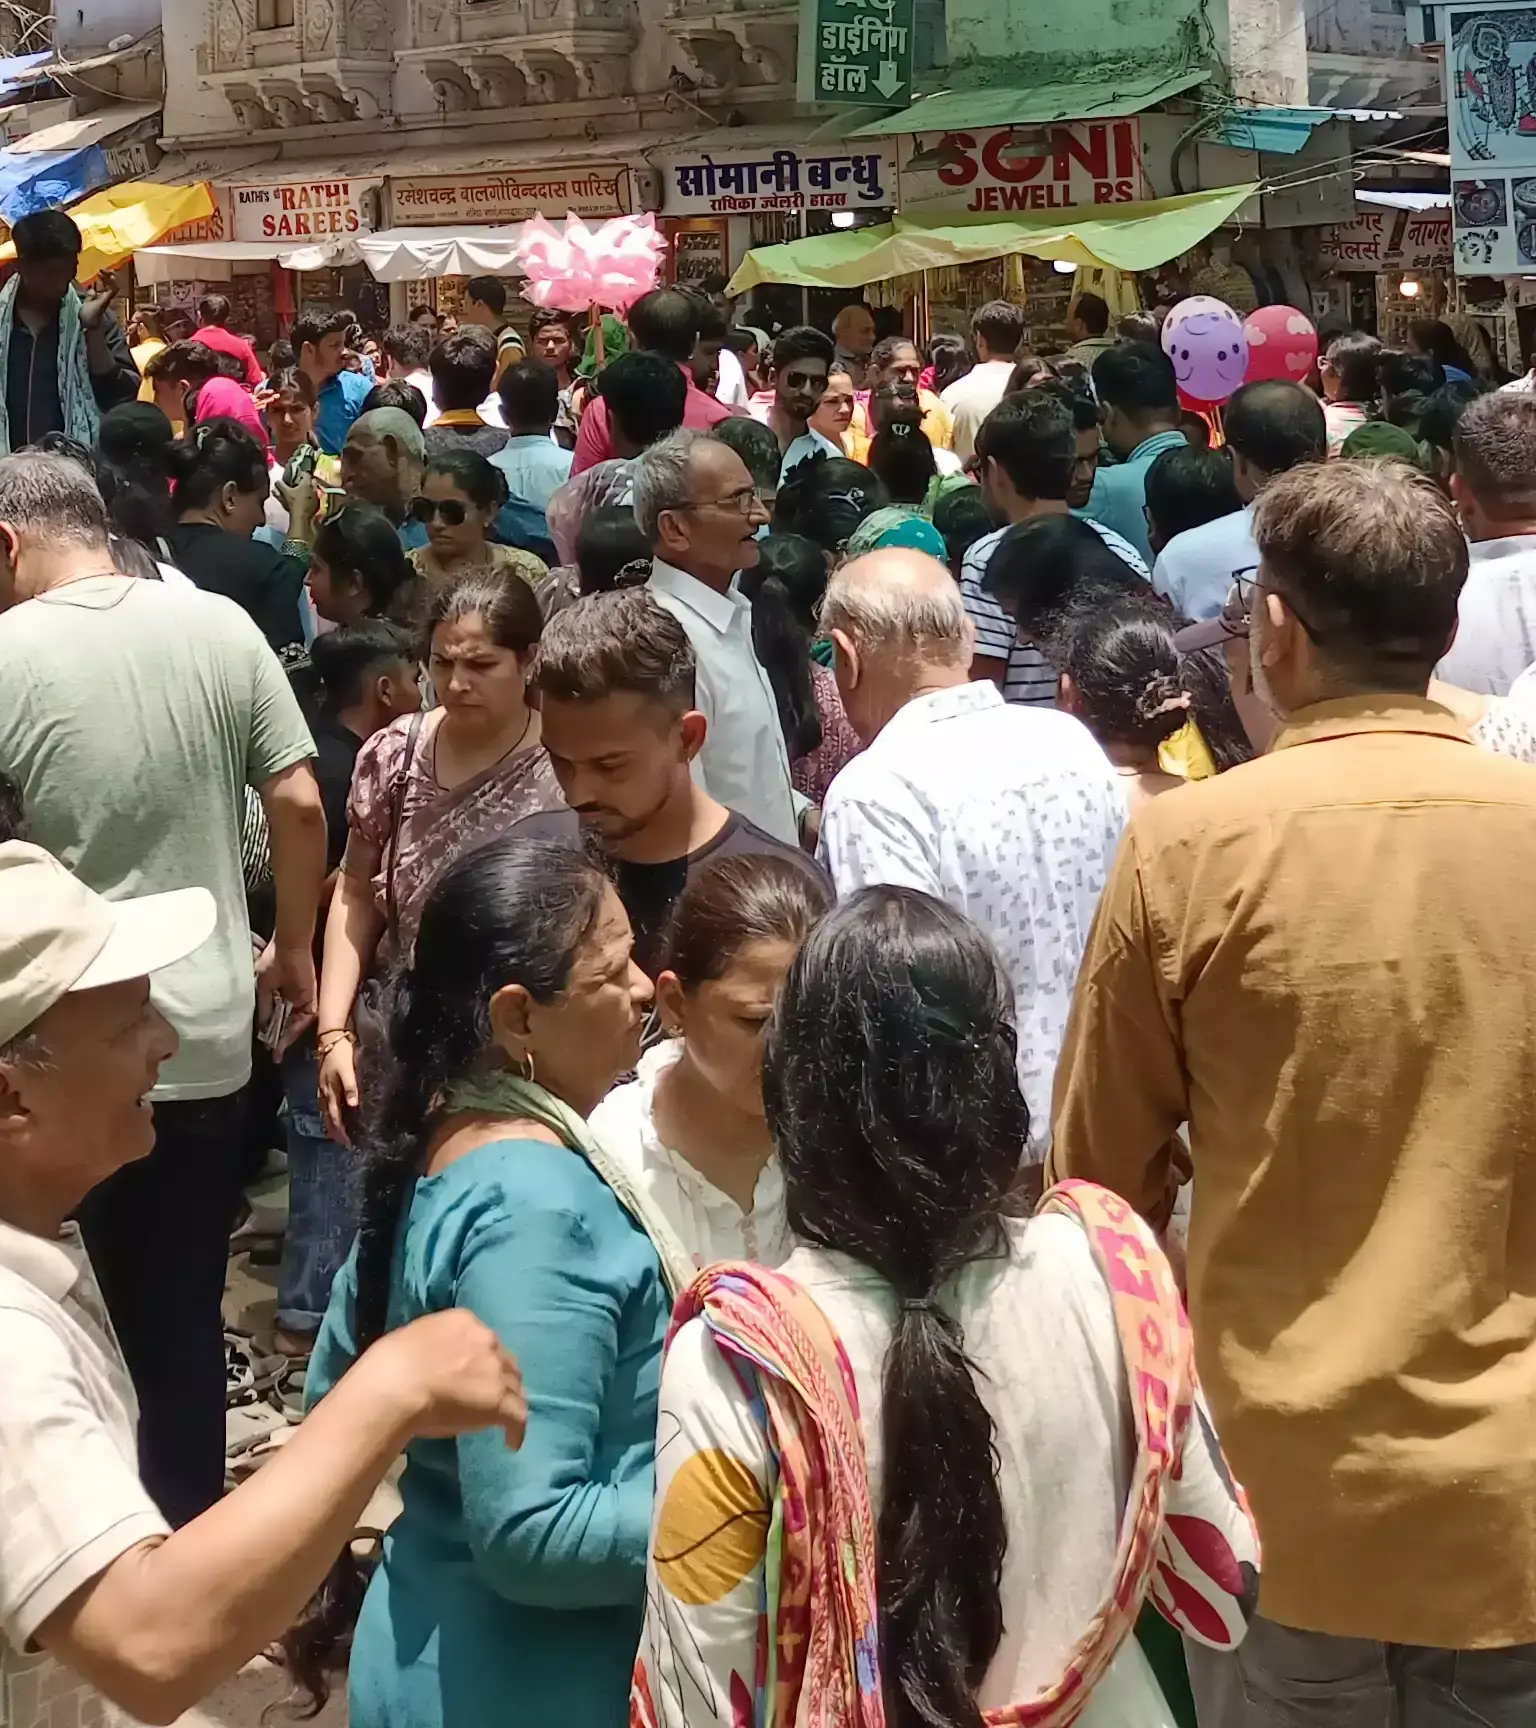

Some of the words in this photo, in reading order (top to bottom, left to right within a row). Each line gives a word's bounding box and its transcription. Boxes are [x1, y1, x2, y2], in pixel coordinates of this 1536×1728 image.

[820, 54, 870, 93] हॉल
[675, 150, 803, 197] सोमानी
[805, 154, 885, 201] बन्धु
[279, 182, 350, 211] RATHI
[263, 208, 360, 237] SAREES
